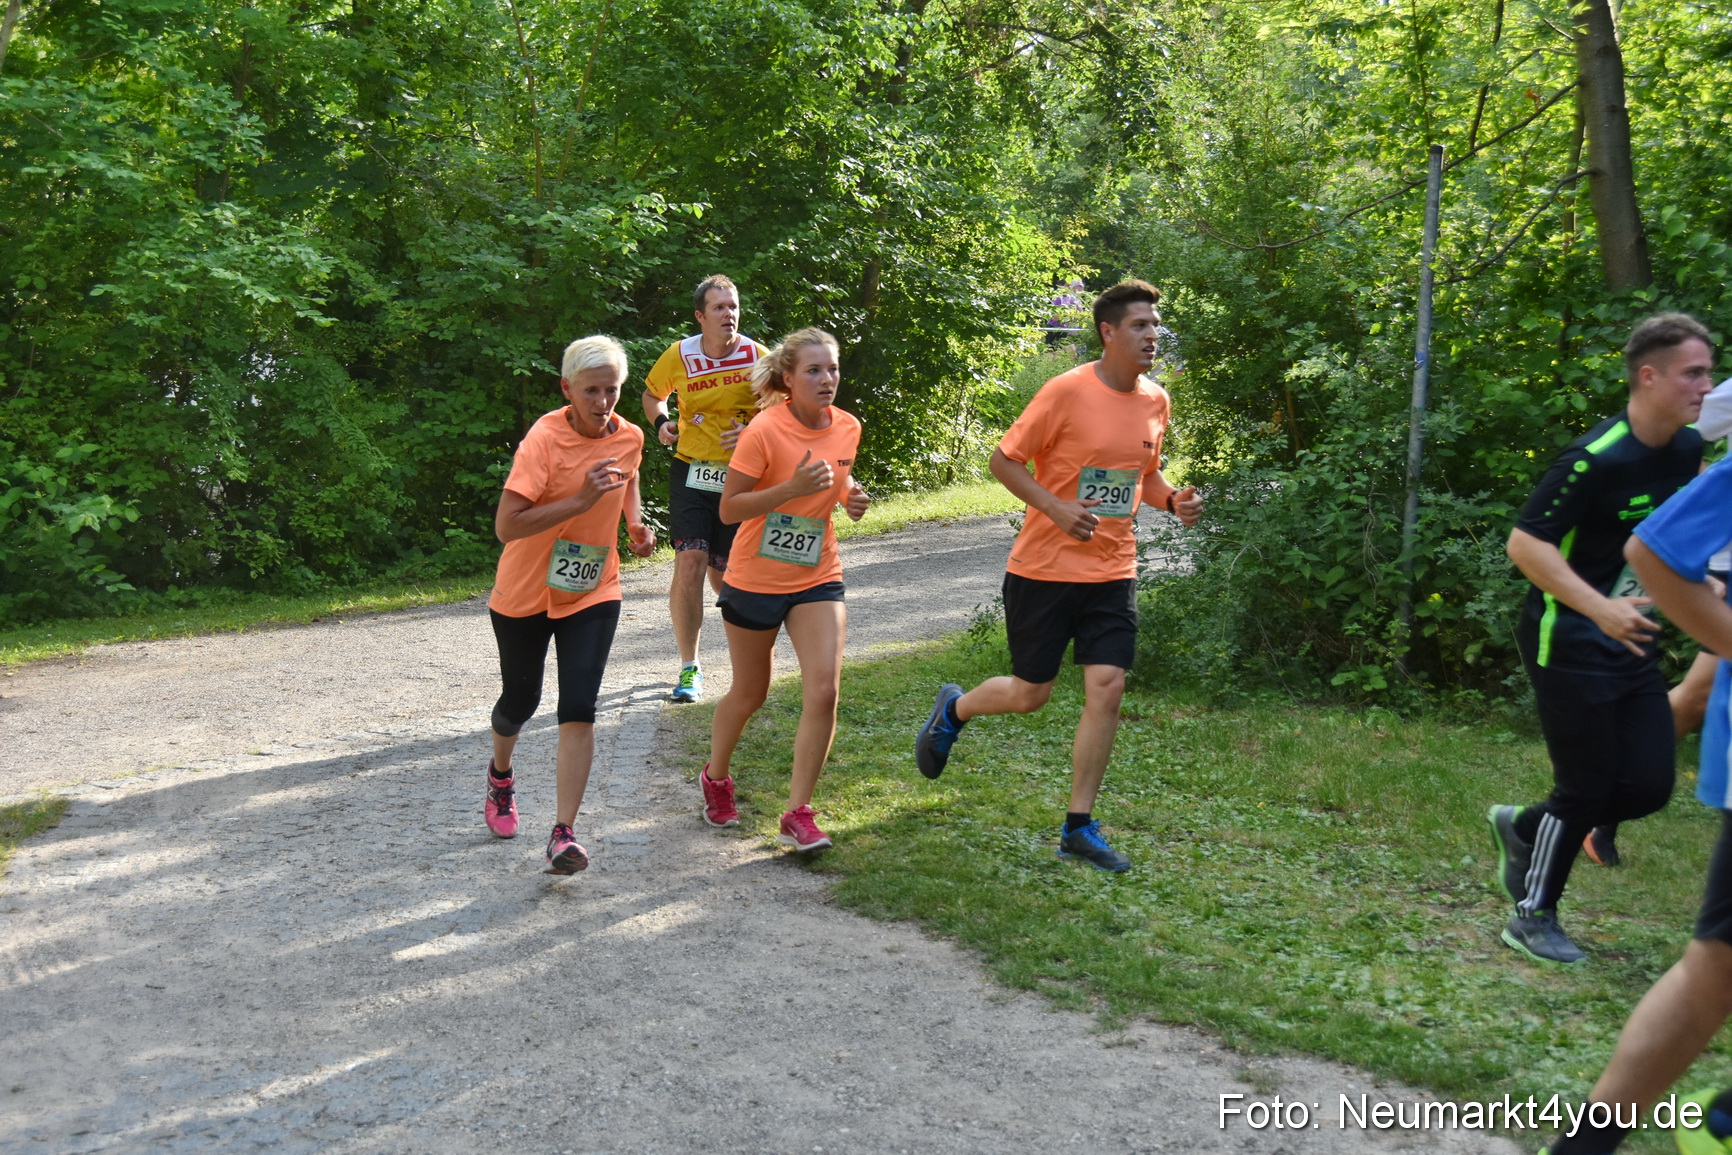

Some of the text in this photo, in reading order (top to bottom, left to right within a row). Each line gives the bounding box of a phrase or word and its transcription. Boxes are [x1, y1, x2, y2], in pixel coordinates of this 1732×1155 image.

[687, 377, 718, 392] MAX
[695, 467, 727, 484] 1640
[1084, 484, 1130, 504] 2290
[768, 529, 817, 552] 2287
[555, 558, 599, 580] 2306
